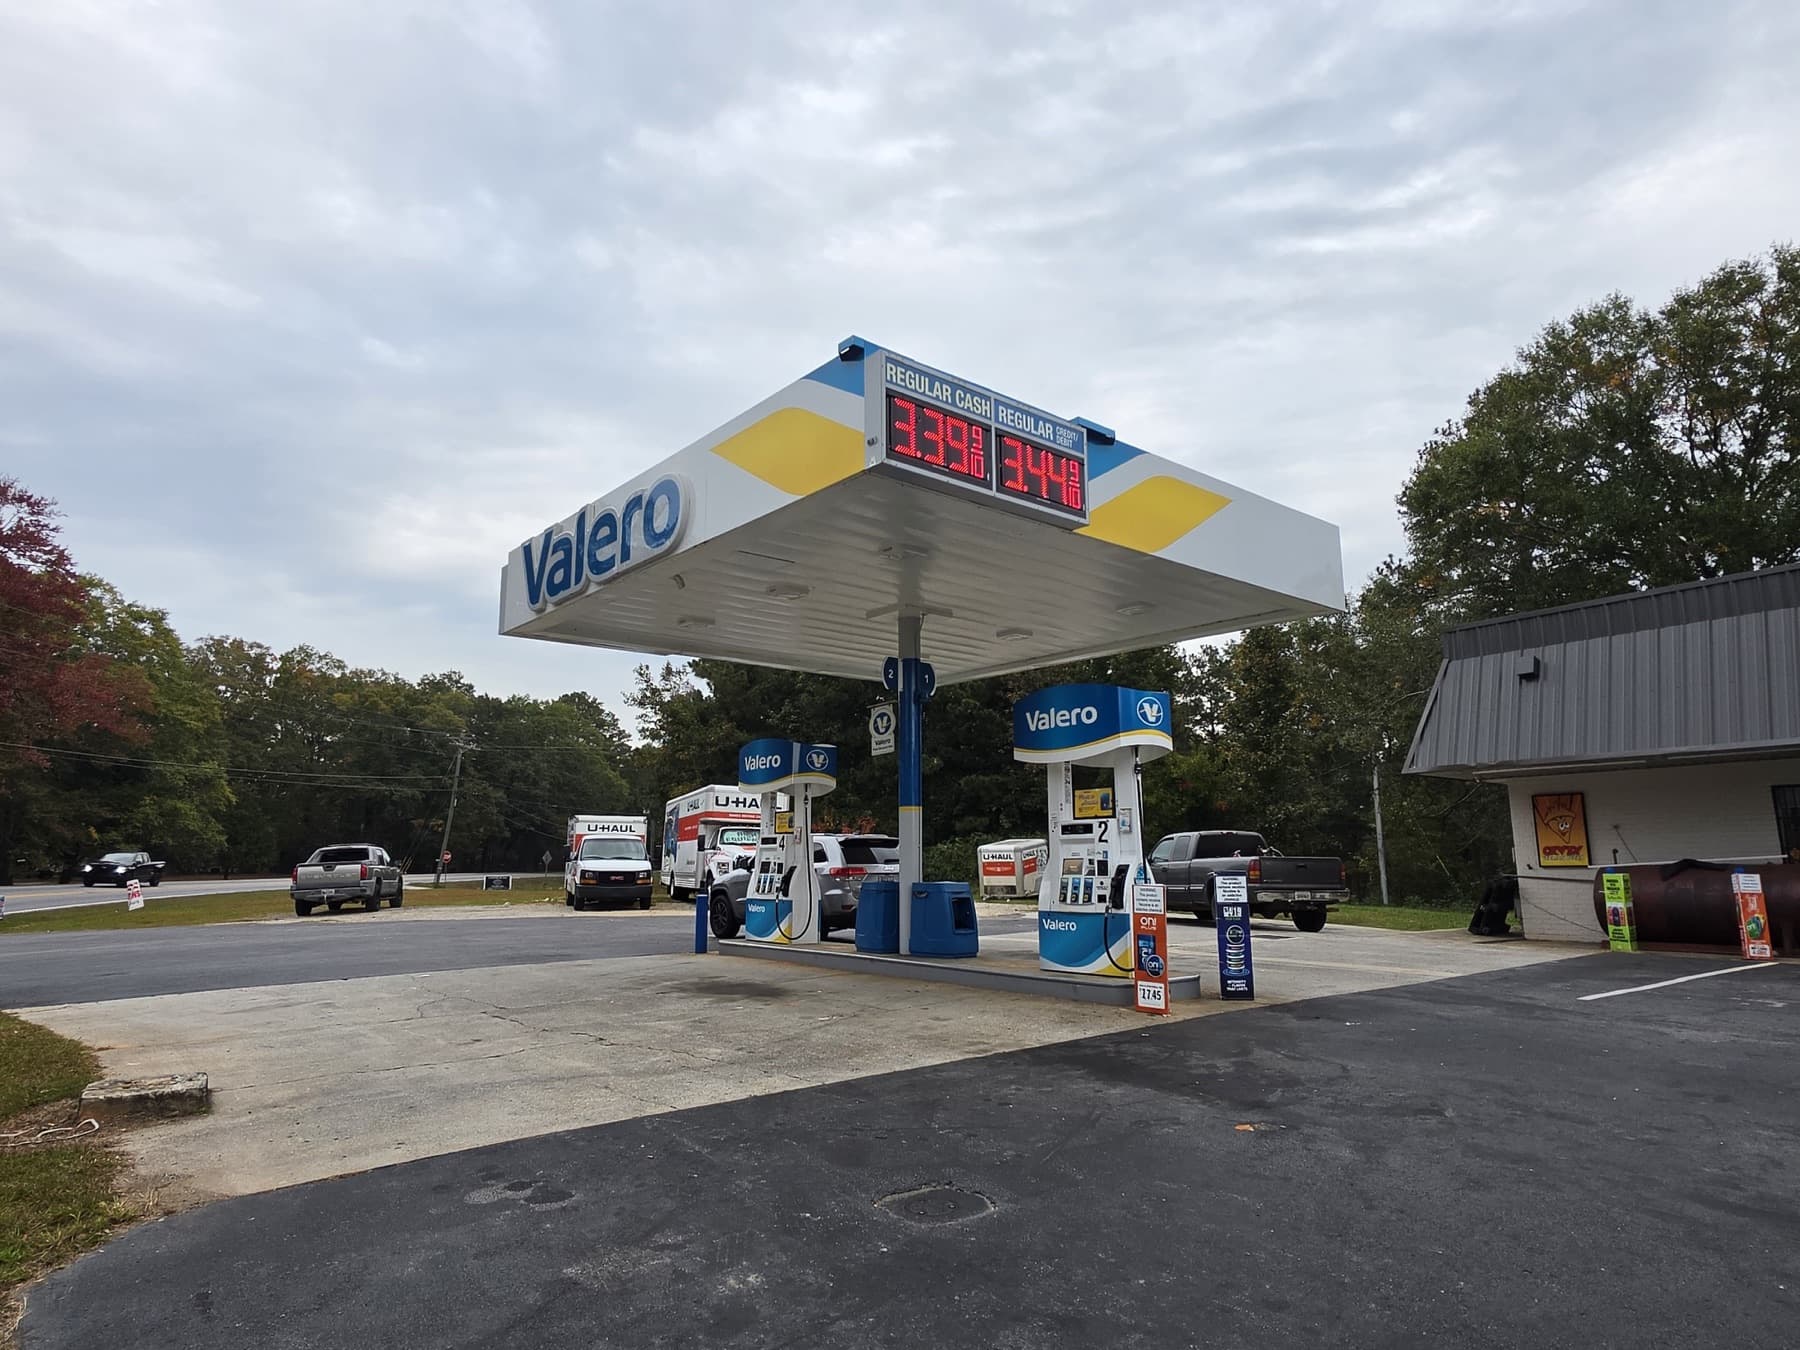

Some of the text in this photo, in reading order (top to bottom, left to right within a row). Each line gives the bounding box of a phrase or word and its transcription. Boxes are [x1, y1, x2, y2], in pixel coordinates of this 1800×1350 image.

[886, 362, 991, 418] REGULAR CASH
[998, 405, 1053, 441] REGULAR
[1056, 434, 1073, 449] DEBIT
[523, 479, 680, 605] Valero
[888, 669, 894, 679] 2
[924, 674, 929, 684] 1
[1026, 706, 1098, 732] Valero
[745, 754, 781, 771] Valero
[587, 823, 637, 833] U-HAUL
[1098, 820, 1108, 843] 2
[779, 836, 786, 852] 4
[748, 904, 766, 913] Valero
[1042, 918, 1077, 931] Valero
